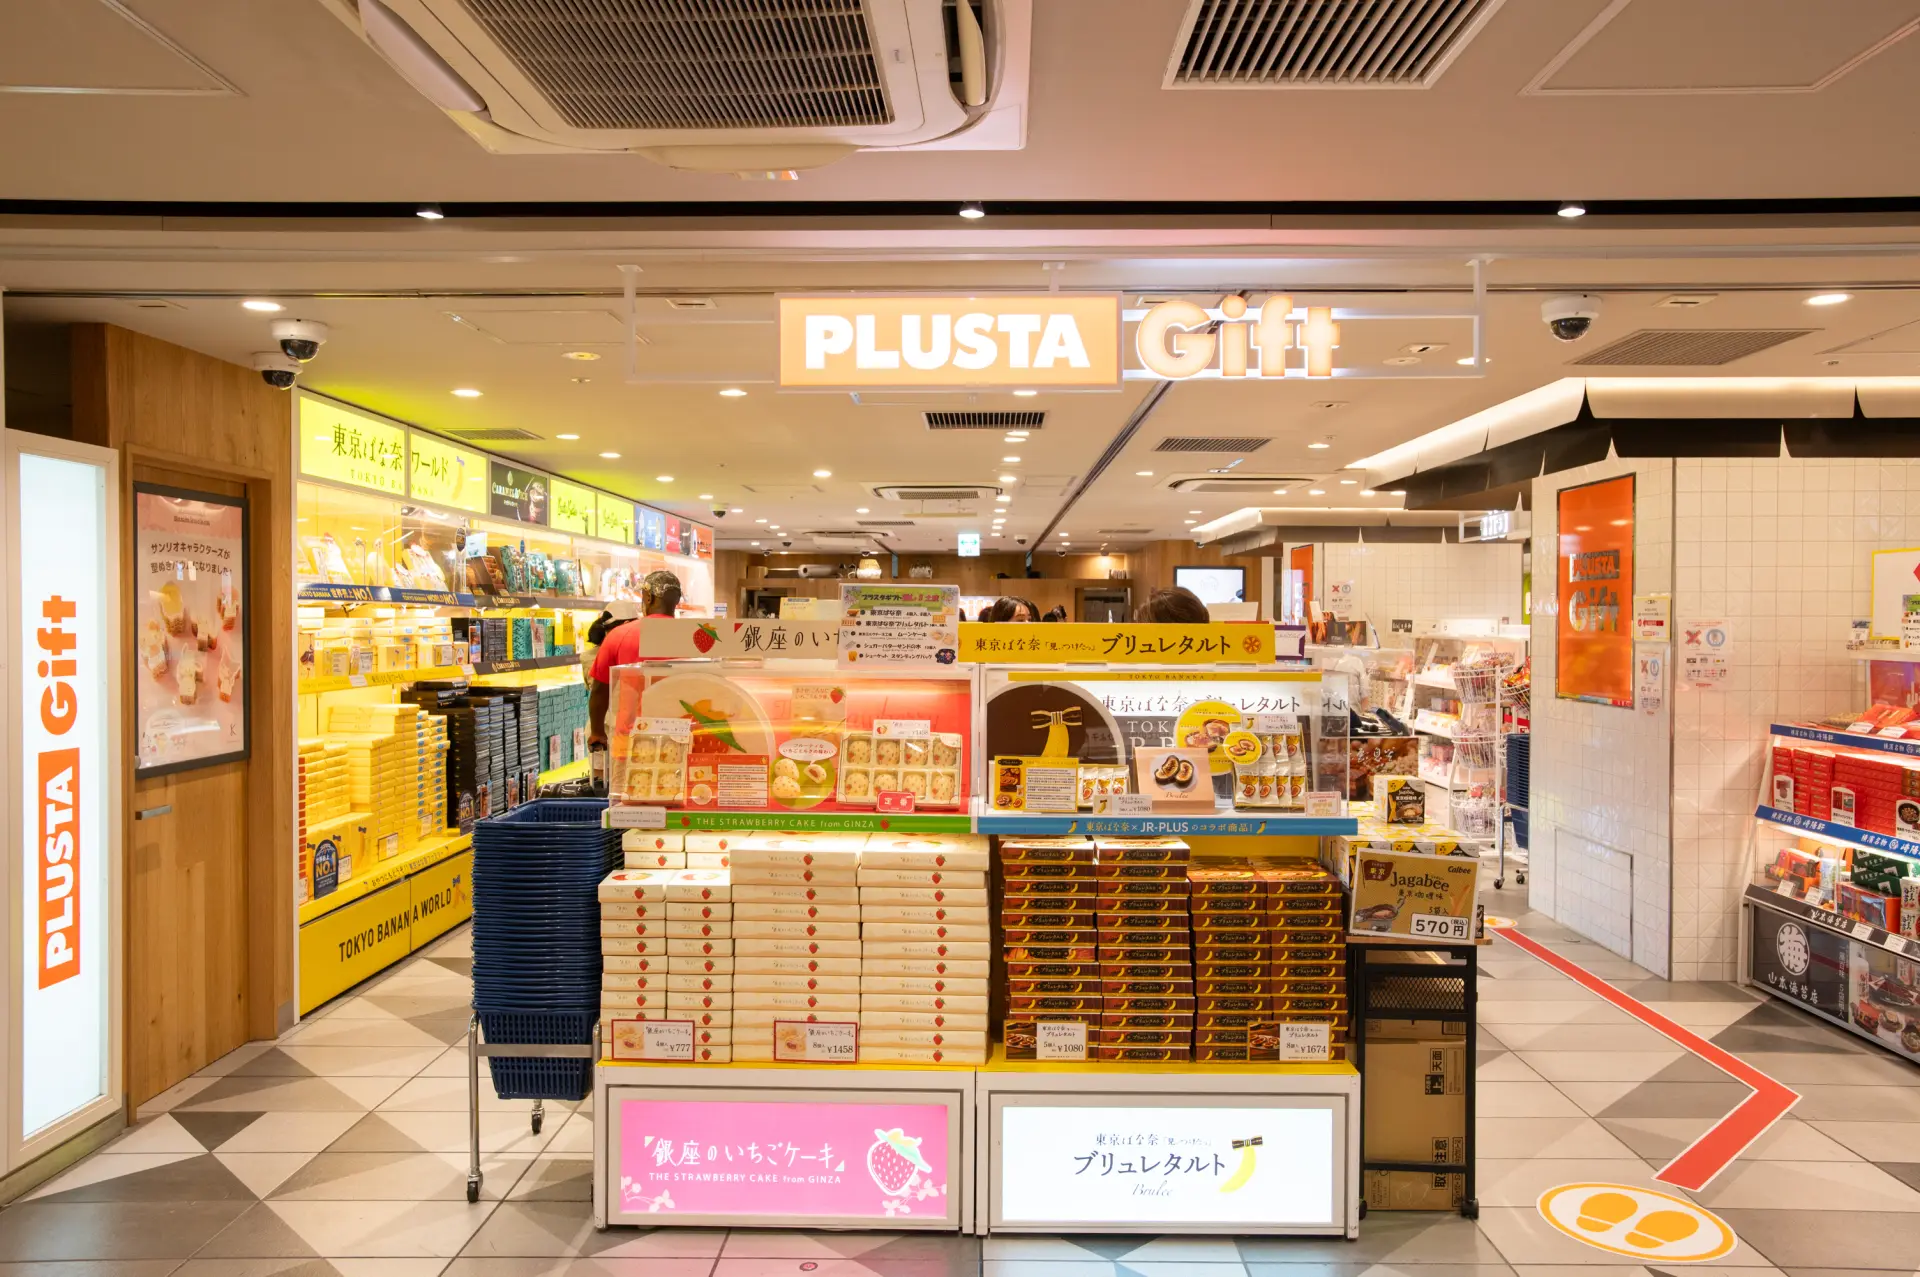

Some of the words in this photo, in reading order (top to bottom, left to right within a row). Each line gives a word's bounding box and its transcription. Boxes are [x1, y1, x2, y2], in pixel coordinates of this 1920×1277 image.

[805, 313, 1091, 370] PLUSTA
[1136, 295, 1341, 379] Gift
[351, 469, 385, 487] TOKYO
[151, 542, 230, 559] サンリオキャラクターズが
[870, 609, 902, 617] 東京ばな奈
[1569, 586, 1620, 632] Gift
[975, 634, 1040, 651] 東京ばな奈
[1101, 633, 1231, 656] ブリュレタルト
[37, 594, 80, 736] Gift
[1128, 673, 1161, 681] TOKYO
[1165, 673, 1205, 681] BANANA
[1127, 721, 1174, 733] TOK
[697, 817, 717, 827] THE
[719, 818, 786, 828] STRAWBERRY
[789, 819, 816, 828] CAKE
[820, 820, 842, 829] from
[844, 820, 875, 829] GINZA
[1140, 822, 1189, 832] JR-PLUS
[1802, 820, 1826, 831] 崎陽軒
[1900, 843, 1920, 856] 崎陽
[46, 765, 74, 969] PLUSTA
[316, 852, 336, 878] NO.1
[1447, 866, 1472, 875] Calbee
[1390, 871, 1450, 892] Jagabee
[1428, 906, 1449, 916] 5袋入
[339, 928, 374, 962] TOKYO
[377, 906, 419, 943] BANANA
[421, 888, 451, 923] WORLD
[1415, 919, 1449, 935] 570
[1453, 926, 1464, 937] 円
[1767, 972, 1818, 1004] 山本海苔店
[670, 1043, 691, 1052] ¥777
[827, 1045, 854, 1054] ¥1458
[1057, 1044, 1084, 1053] ¥1080
[1300, 1045, 1327, 1054] ¥1674
[1431, 1050, 1443, 1072] 天面
[1095, 1133, 1159, 1146] 東京ばな奈
[1073, 1150, 1226, 1176] ブリュレタルト
[649, 1172, 670, 1181] THE
[674, 1173, 746, 1183] STRAWBERRY
[749, 1174, 778, 1183] CAKE
[783, 1175, 805, 1184] from
[808, 1175, 841, 1184] GINZA
